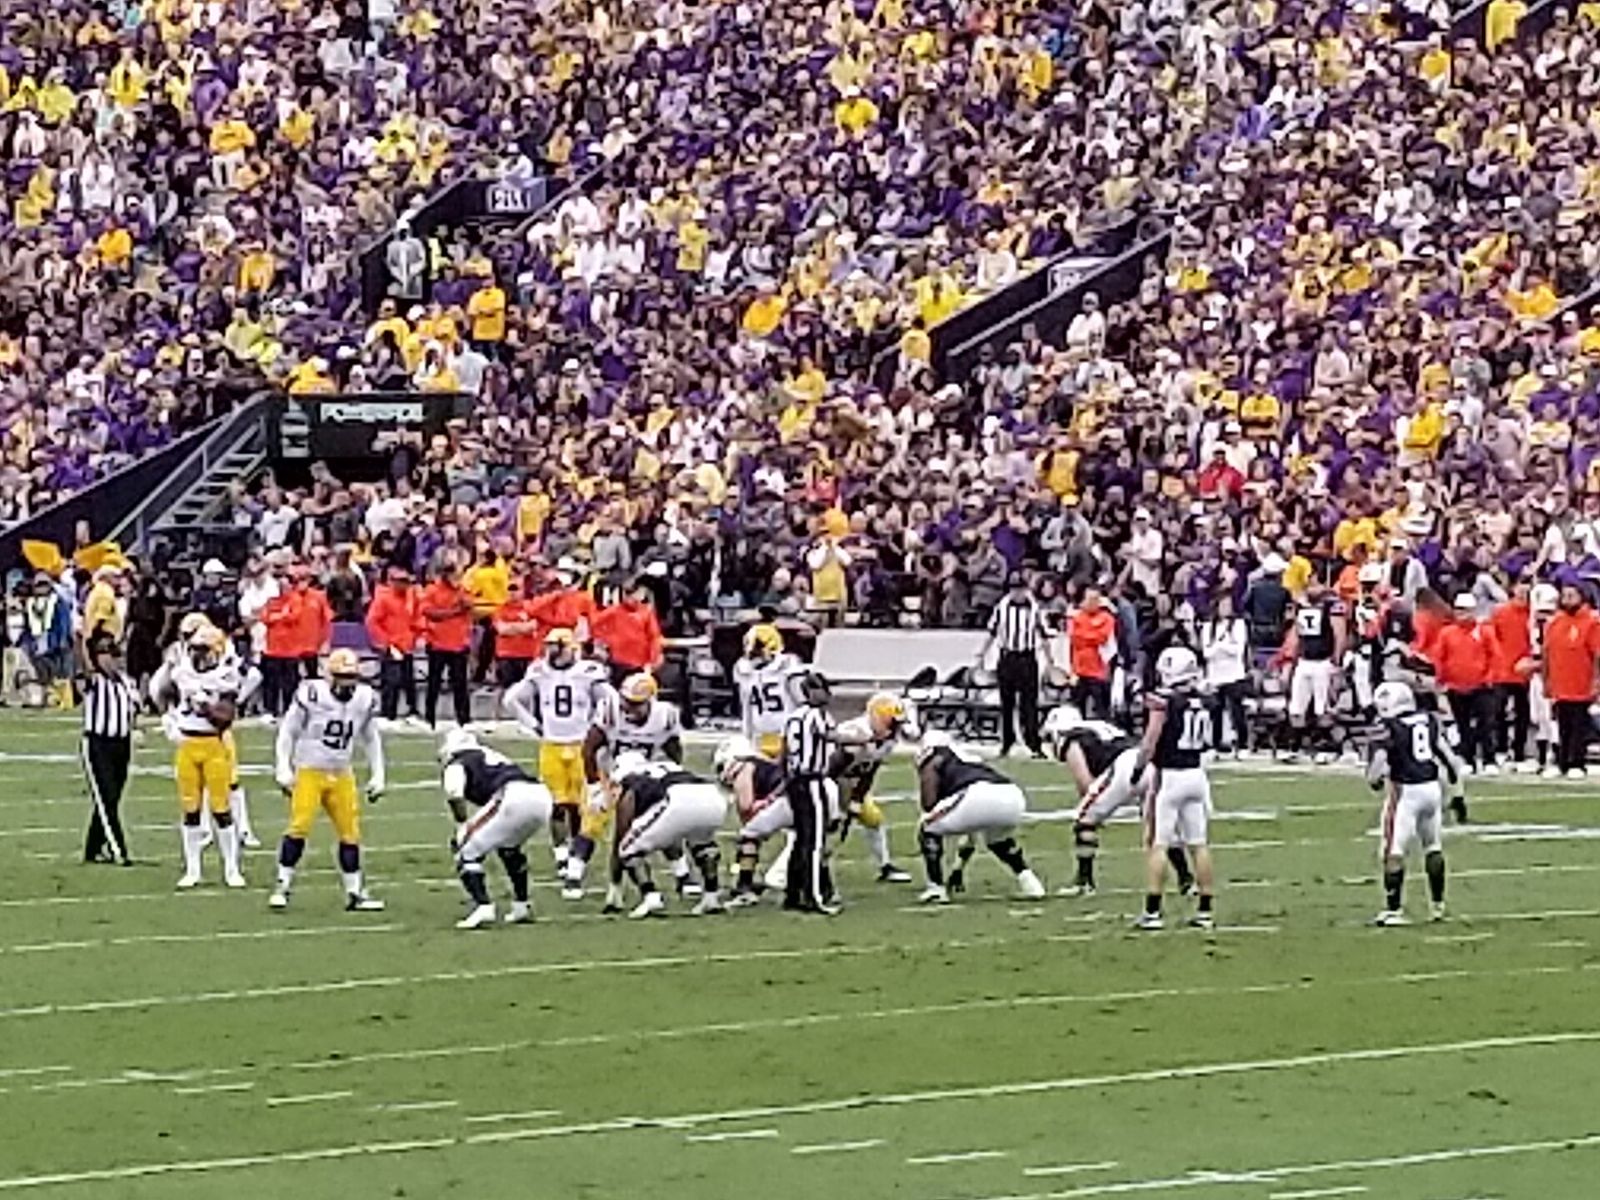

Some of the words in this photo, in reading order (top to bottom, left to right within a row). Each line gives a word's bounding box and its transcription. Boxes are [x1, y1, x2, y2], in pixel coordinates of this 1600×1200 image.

[554, 684, 573, 718] 8
[750, 682, 784, 716] 45
[322, 719, 354, 750] 91
[1177, 709, 1214, 751] 10
[1412, 723, 1433, 762] 8
